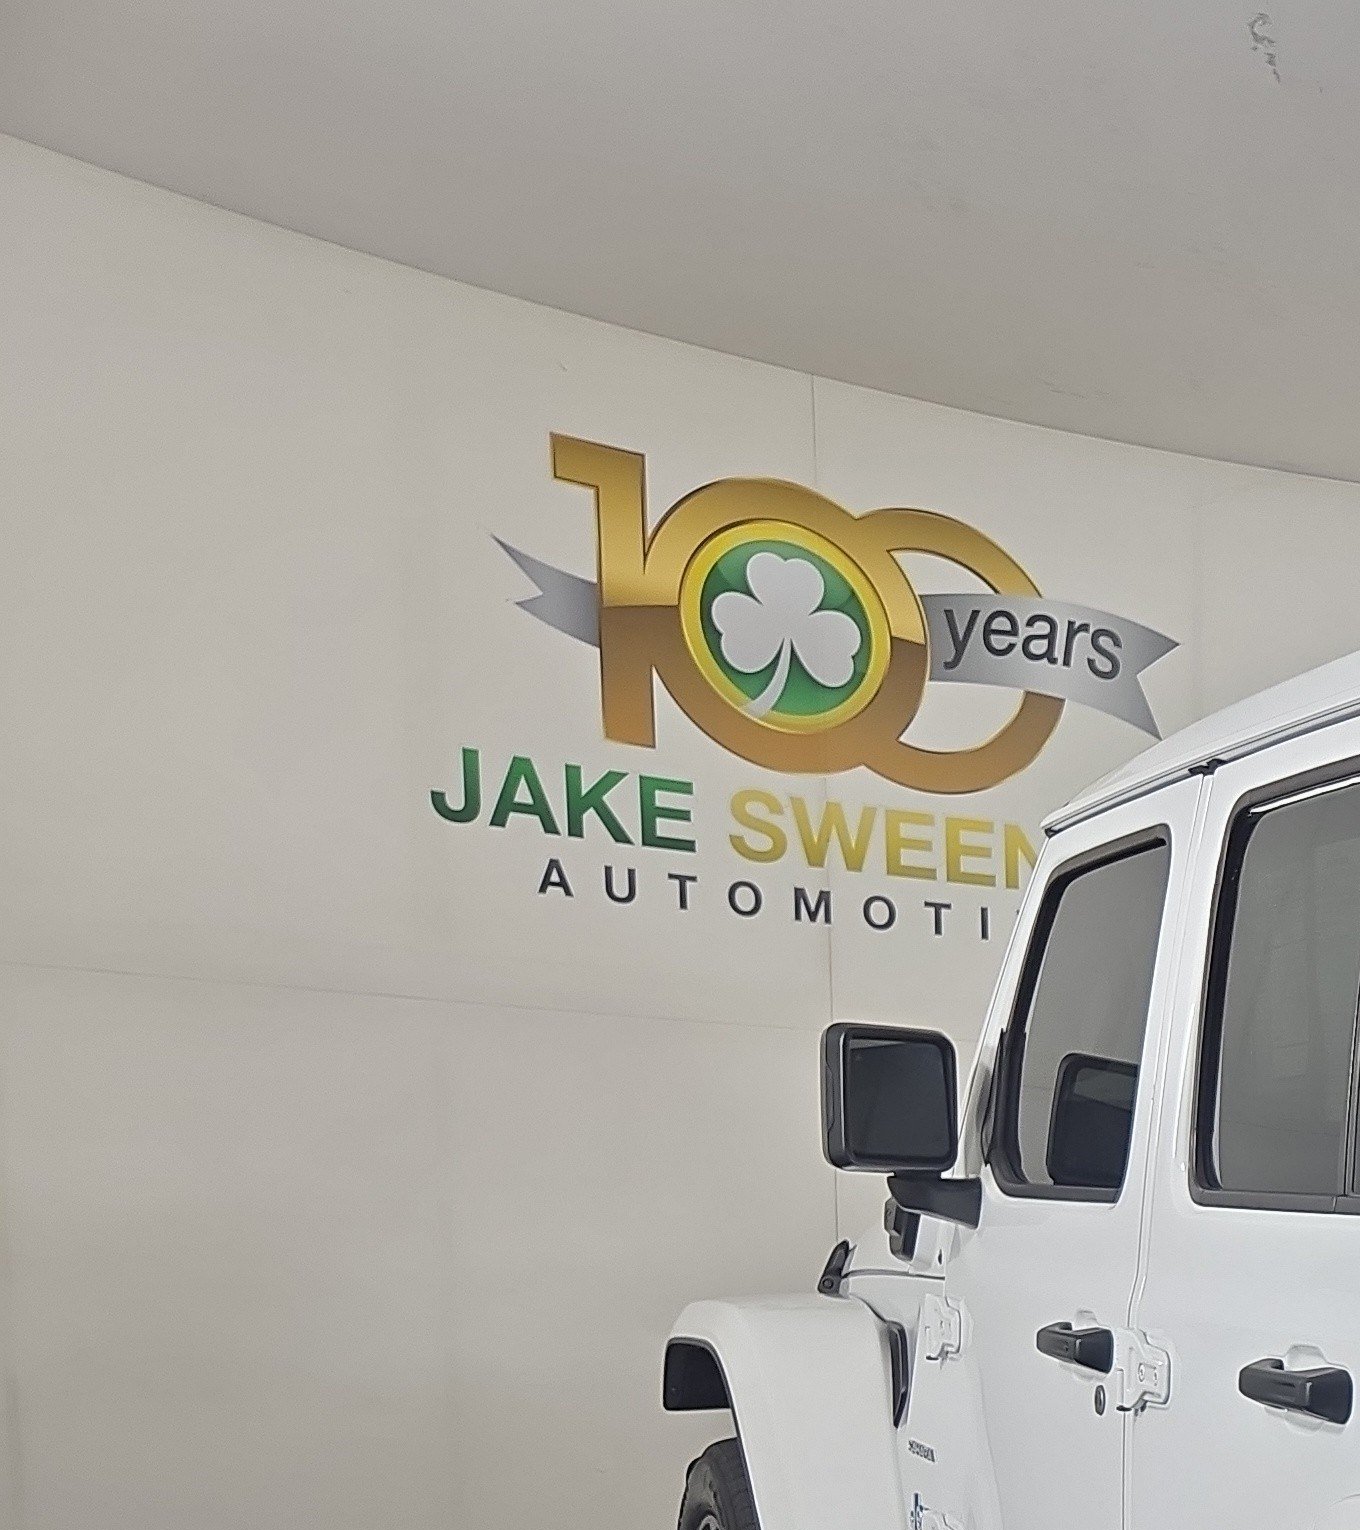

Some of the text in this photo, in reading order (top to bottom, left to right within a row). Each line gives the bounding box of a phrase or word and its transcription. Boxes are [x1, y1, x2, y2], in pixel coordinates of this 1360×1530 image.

[942, 607, 1122, 680] years
[430, 747, 1040, 891] JAKE SWEEN
[538, 857, 1020, 941] AUTOMOTI
